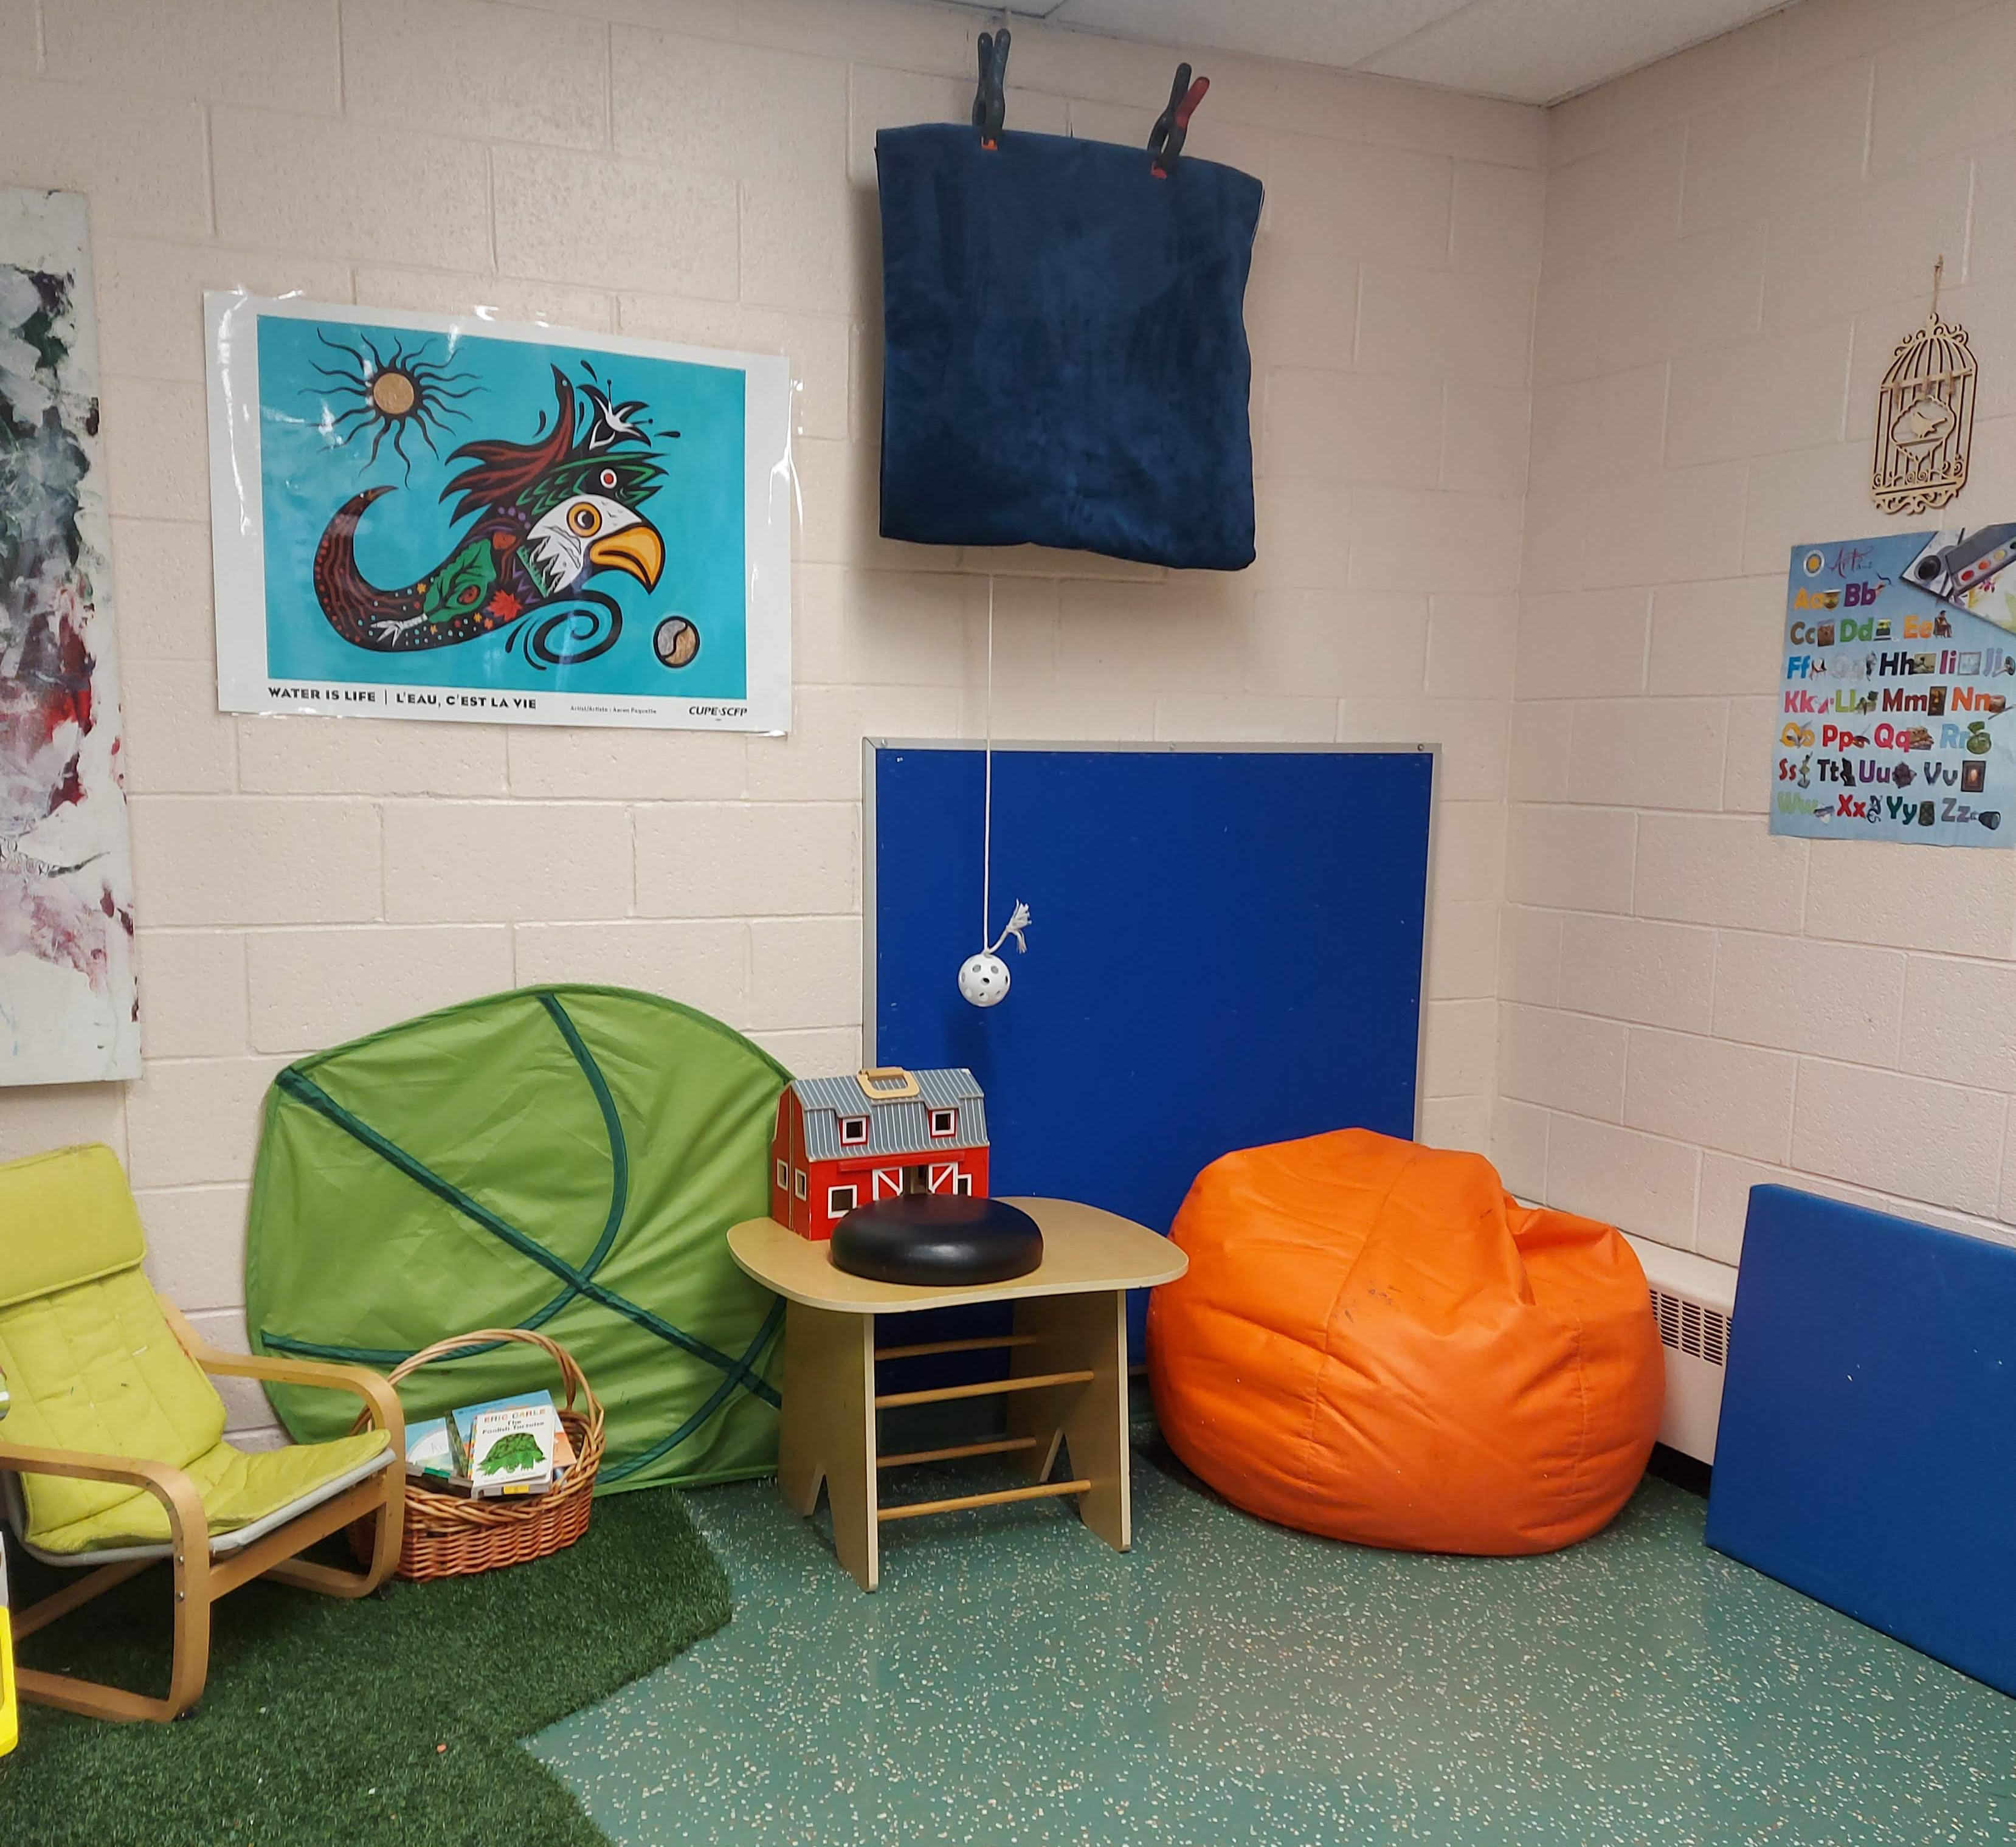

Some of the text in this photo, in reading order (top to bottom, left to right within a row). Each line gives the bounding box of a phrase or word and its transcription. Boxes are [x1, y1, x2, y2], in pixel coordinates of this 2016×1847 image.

[1794, 581, 1877, 610] Aa Bb
[1790, 615, 1932, 645] Cc Dd Ee
[1787, 655, 1811, 679] Ff
[1879, 652, 1915, 676] Hh
[268, 687, 376, 702] WATER IS LIFE
[396, 691, 536, 709] L'EAU, C'EST LA VIE
[1784, 690, 1818, 713] Kk
[1882, 688, 1927, 712] Mm
[1951, 686, 1992, 711] Nn
[1781, 722, 1970, 753] Oo Pp Qq Rr
[1779, 758, 1958, 786] Ss Tt Uu Vv
[1837, 794, 1866, 818] Xx
[1887, 796, 1917, 825] Yy
[1941, 798, 1971, 823] Zz
